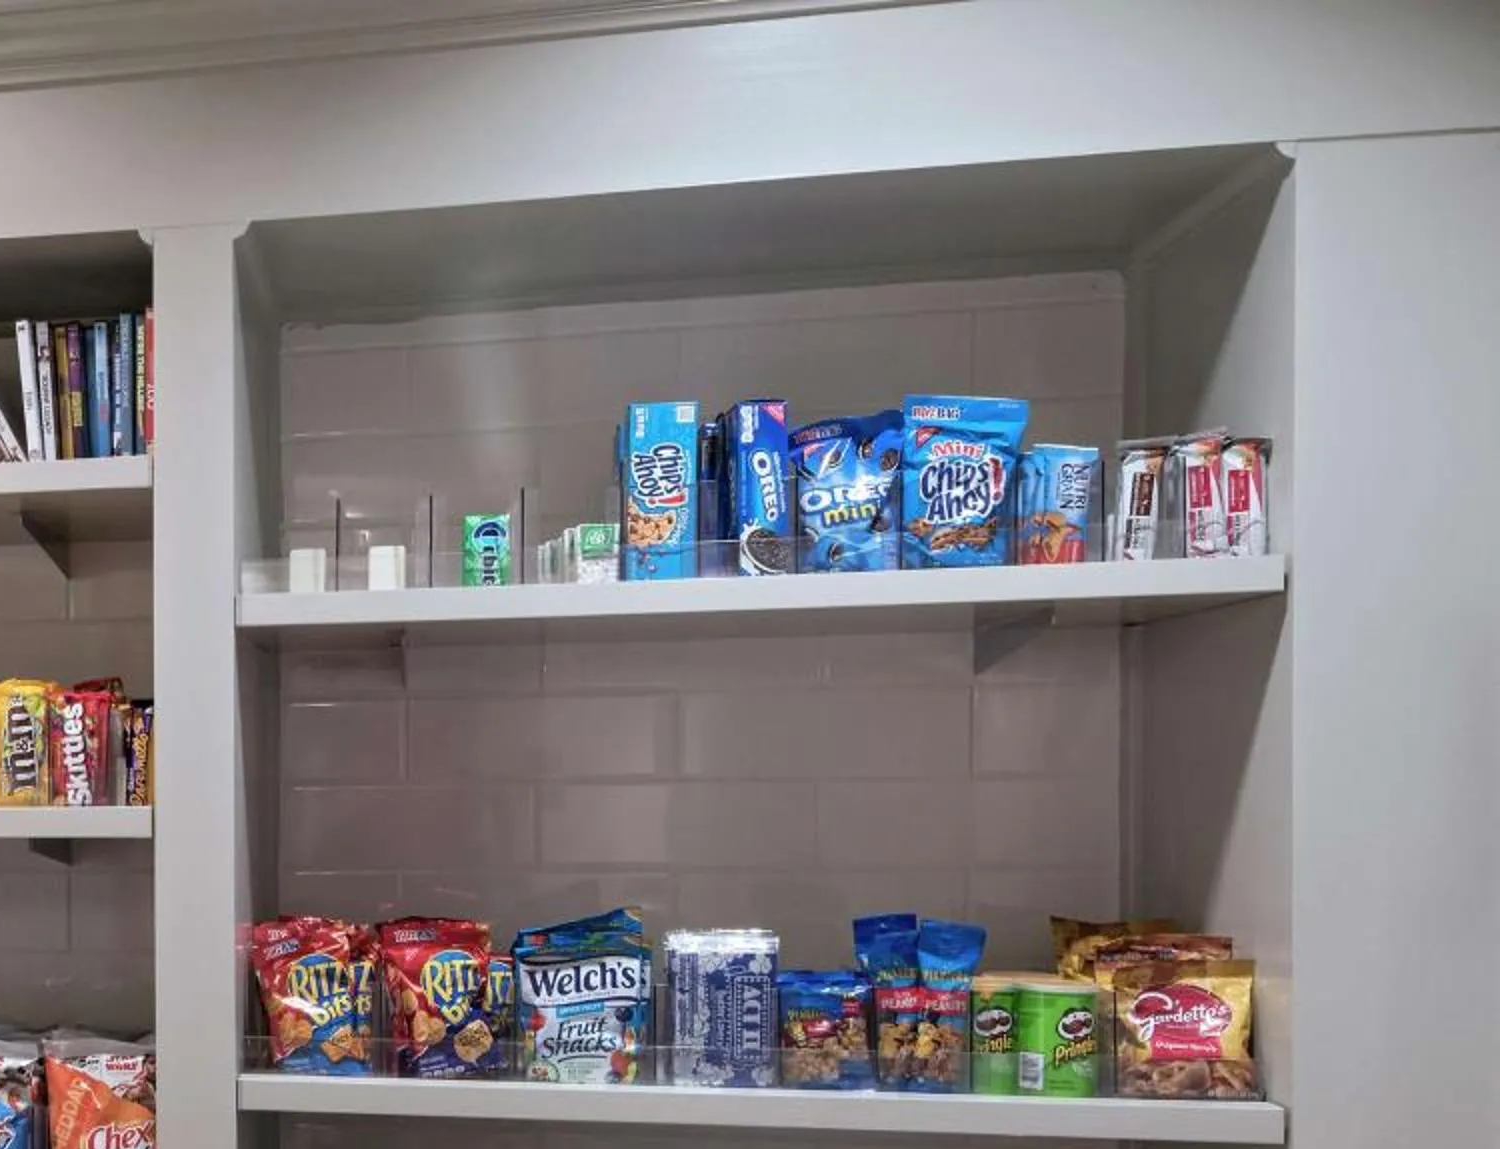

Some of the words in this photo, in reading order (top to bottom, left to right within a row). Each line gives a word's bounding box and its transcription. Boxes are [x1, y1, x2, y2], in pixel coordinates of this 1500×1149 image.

[653, 444, 682, 494] Chips
[752, 451, 780, 521] OREO
[922, 460, 991, 499] Chips
[800, 478, 892, 512] OREO
[289, 960, 350, 1004] RITZ
[525, 961, 636, 998] Welch's
[541, 1035, 618, 1059] Snacks
[557, 1016, 609, 1040] Fruit
